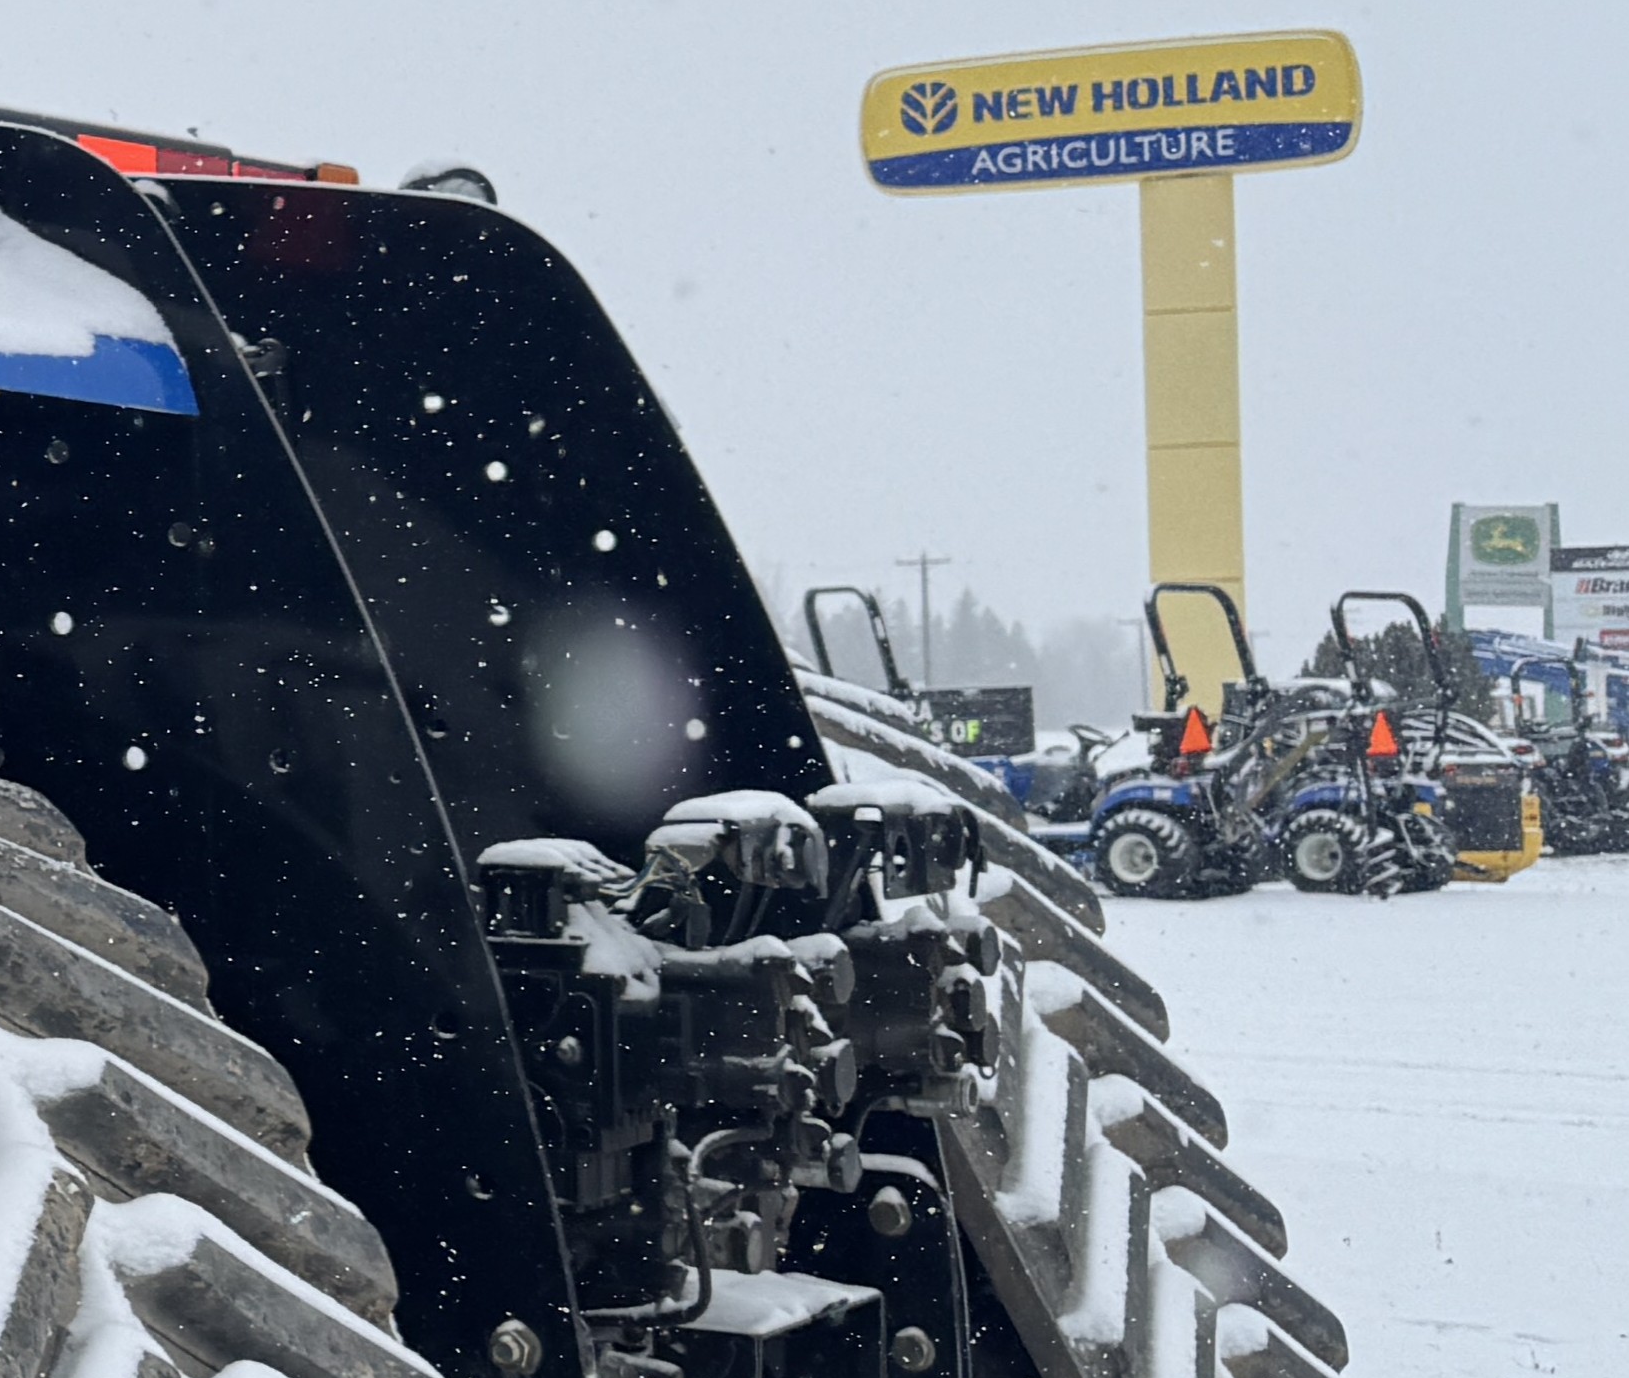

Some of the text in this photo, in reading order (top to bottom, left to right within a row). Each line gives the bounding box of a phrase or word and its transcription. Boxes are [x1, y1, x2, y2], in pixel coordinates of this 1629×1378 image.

[972, 63, 1316, 123] NEW HOLLAND
[971, 128, 1236, 176] AGRICULTURE
[950, 719, 980, 744] OF
